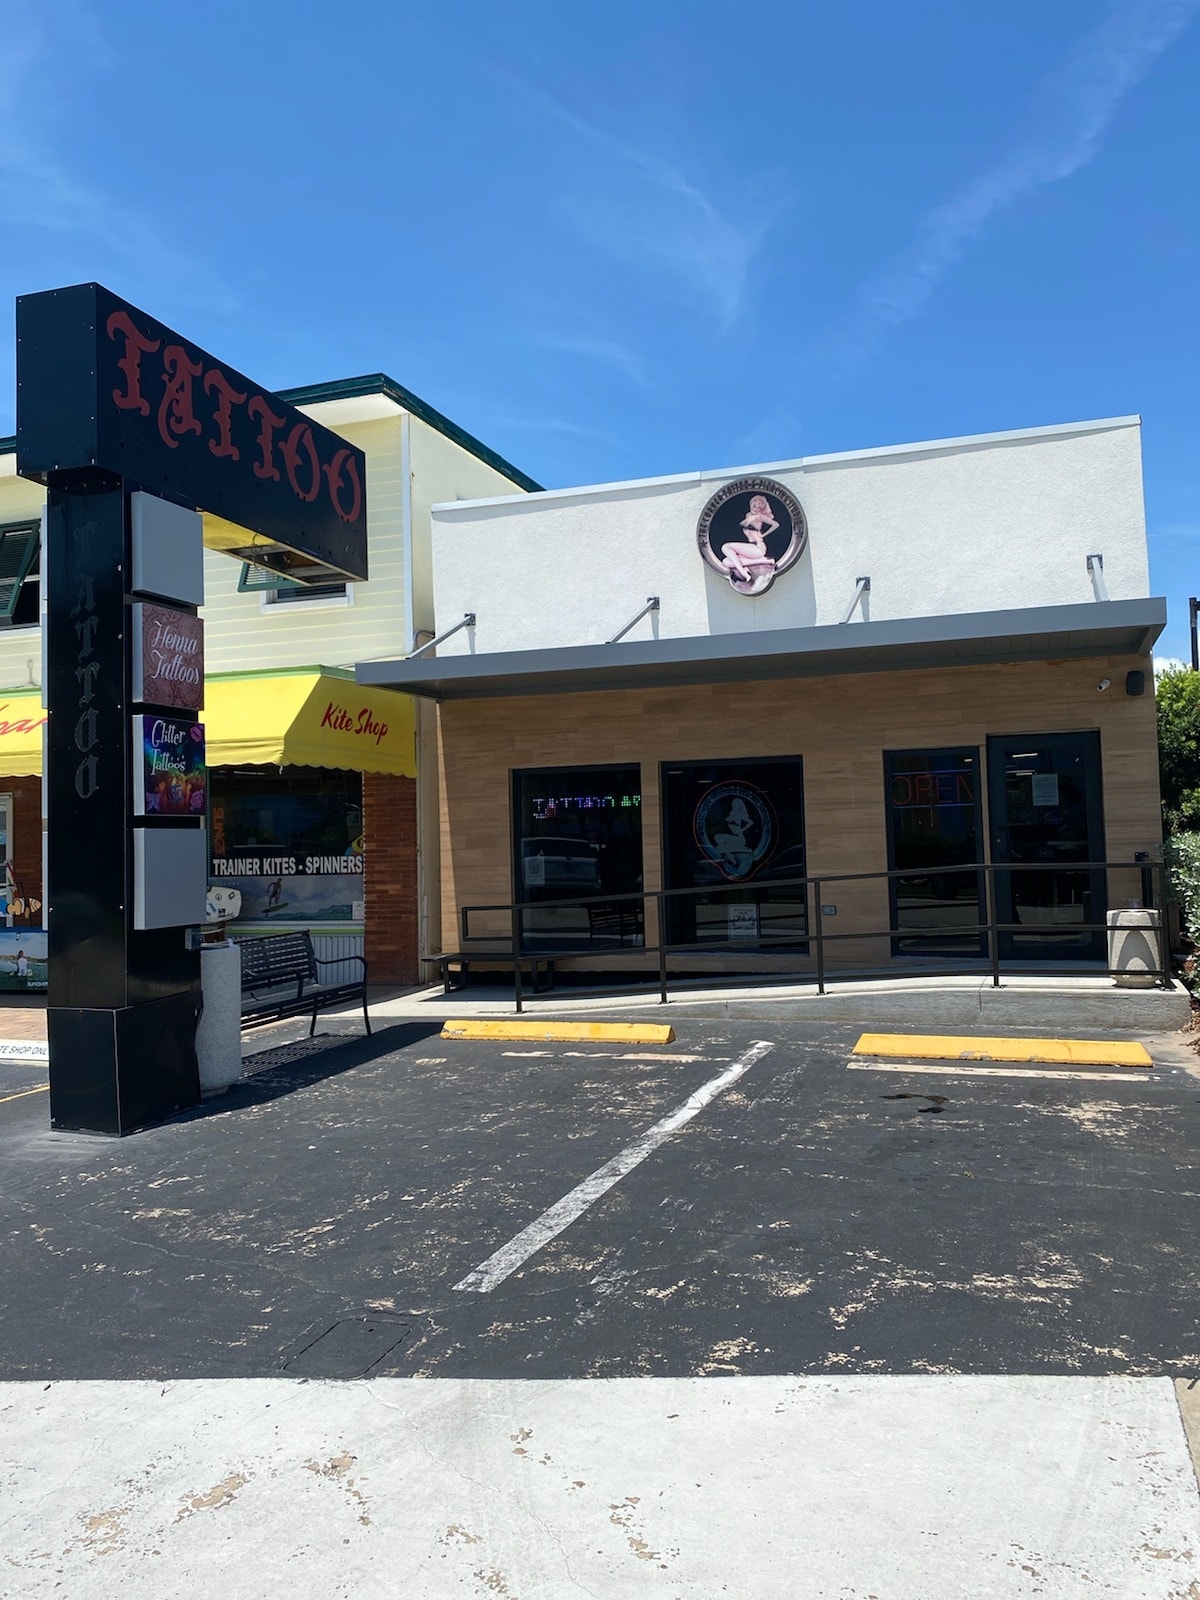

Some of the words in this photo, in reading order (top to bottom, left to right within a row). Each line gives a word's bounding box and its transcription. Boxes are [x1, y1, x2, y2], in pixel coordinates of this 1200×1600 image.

[107, 311, 361, 523] TATTOO
[151, 621, 198, 655] Henna
[151, 649, 200, 685] Tattoos
[151, 720, 187, 746] Glitter
[320, 702, 353, 732] Kite
[354, 707, 389, 745] Shop
[891, 774, 975, 806] OPEN
[213, 857, 261, 876] TRAINER
[263, 856, 296, 875] KITES
[306, 855, 363, 874] SPINNERS
[9, 1046, 32, 1054] SHOP
